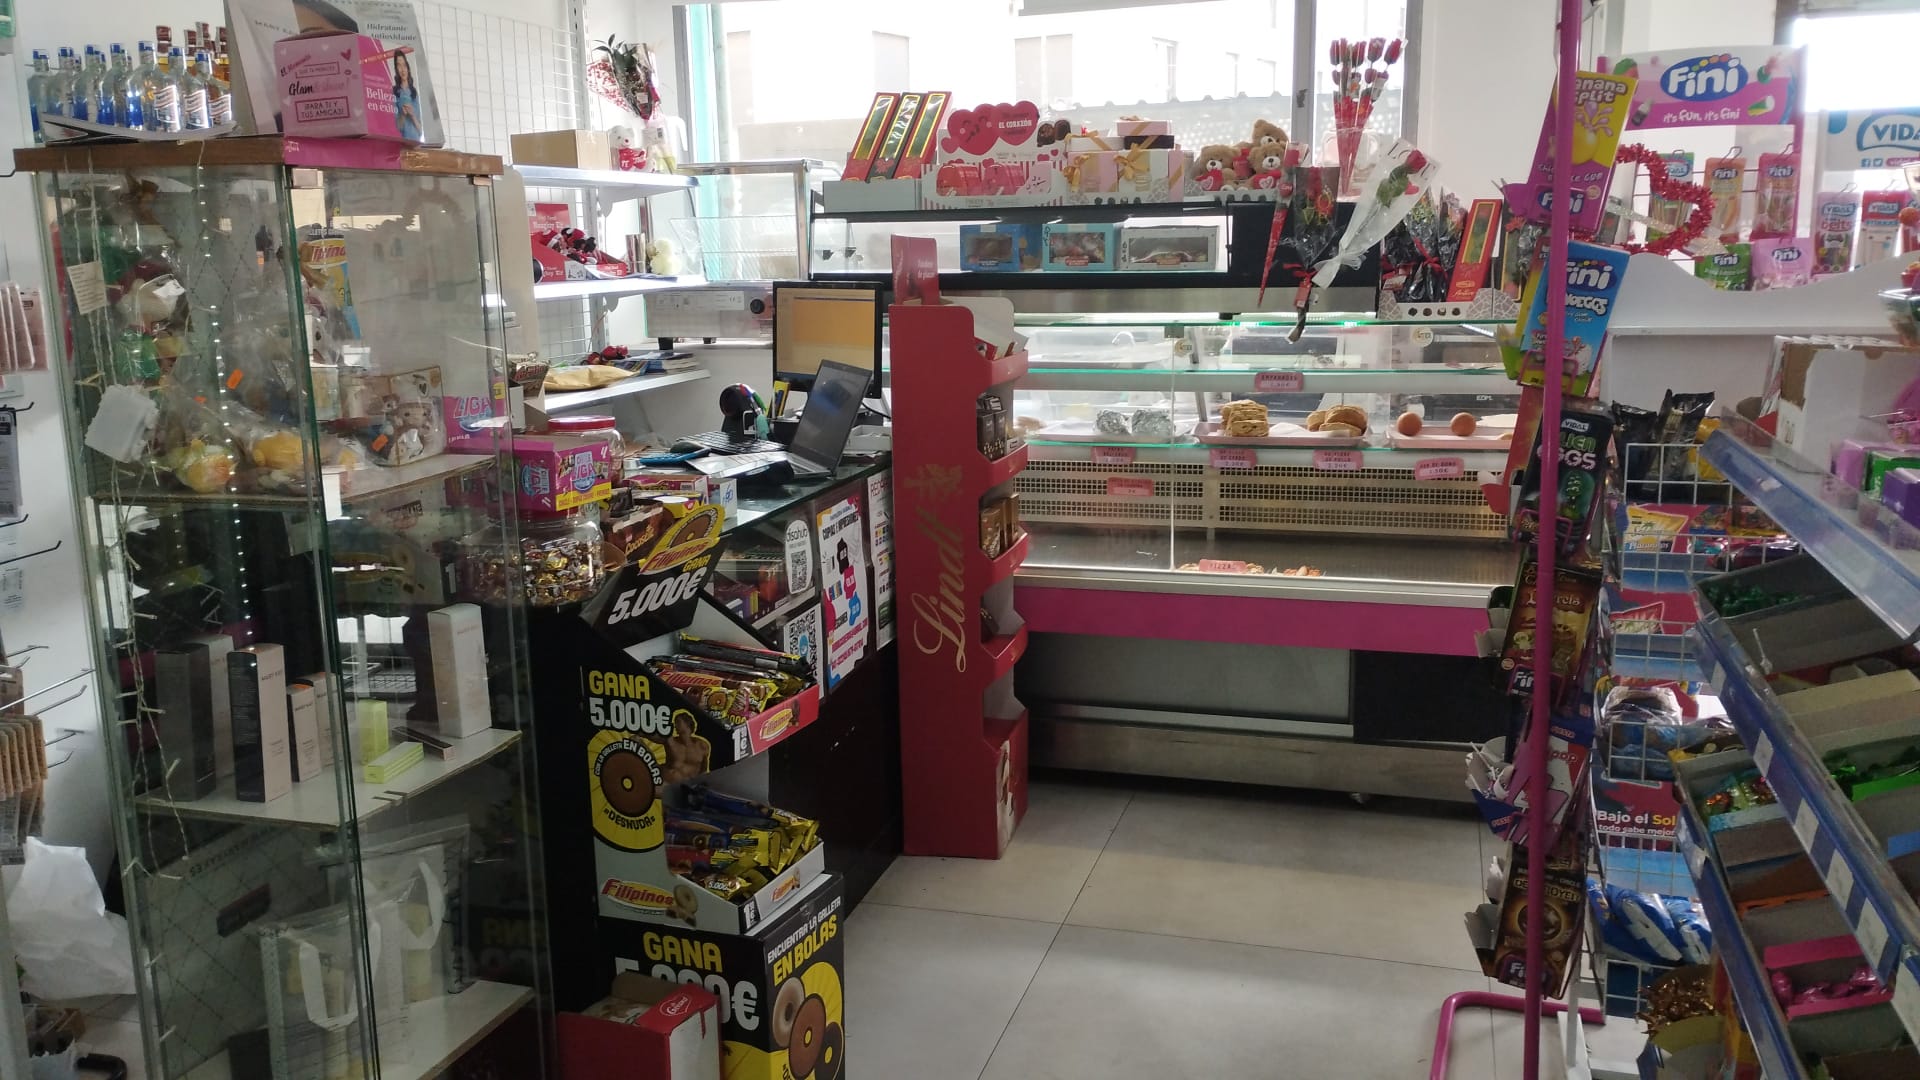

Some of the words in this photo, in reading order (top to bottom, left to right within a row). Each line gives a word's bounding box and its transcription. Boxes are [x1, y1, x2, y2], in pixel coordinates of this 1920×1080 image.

[1574, 77, 1626, 94] anana
[1668, 56, 1740, 98] Fini
[288, 81, 313, 96] Glam
[366, 87, 397, 102] Belleza
[368, 102, 379, 110] en
[380, 101, 398, 114] éxito
[998, 120, 1005, 129] EL
[1006, 117, 1033, 129] CORAZÓN
[1714, 168, 1738, 179] Fini
[1770, 166, 1794, 178] Fini
[1714, 255, 1738, 266] Fini
[1774, 249, 1801, 261] Fini
[1563, 421, 1589, 432] VIDAL
[639, 541, 710, 575] Filipinos
[683, 554, 712, 573] GANA
[607, 566, 708, 625] 5.000€
[911, 505, 967, 673] Lindt
[588, 670, 650, 700] GANA
[589, 696, 672, 736] 5.000€
[623, 738, 638, 751] EN
[637, 746, 663, 786] BOLAS
[1599, 810, 1630, 825] Bajo
[1635, 809, 1649, 824] el
[1653, 812, 1676, 826] Sol
[1600, 824, 1620, 834] todo
[1622, 825, 1646, 835] sabe
[601, 878, 673, 907] Filipinos
[767, 923, 808, 963] ENCUENTRA
[809, 916, 818, 931] LA
[818, 896, 841, 921] GALLETA
[642, 931, 723, 973] GANA
[772, 958, 792, 987] EN
[794, 914, 838, 970] BOLAS
